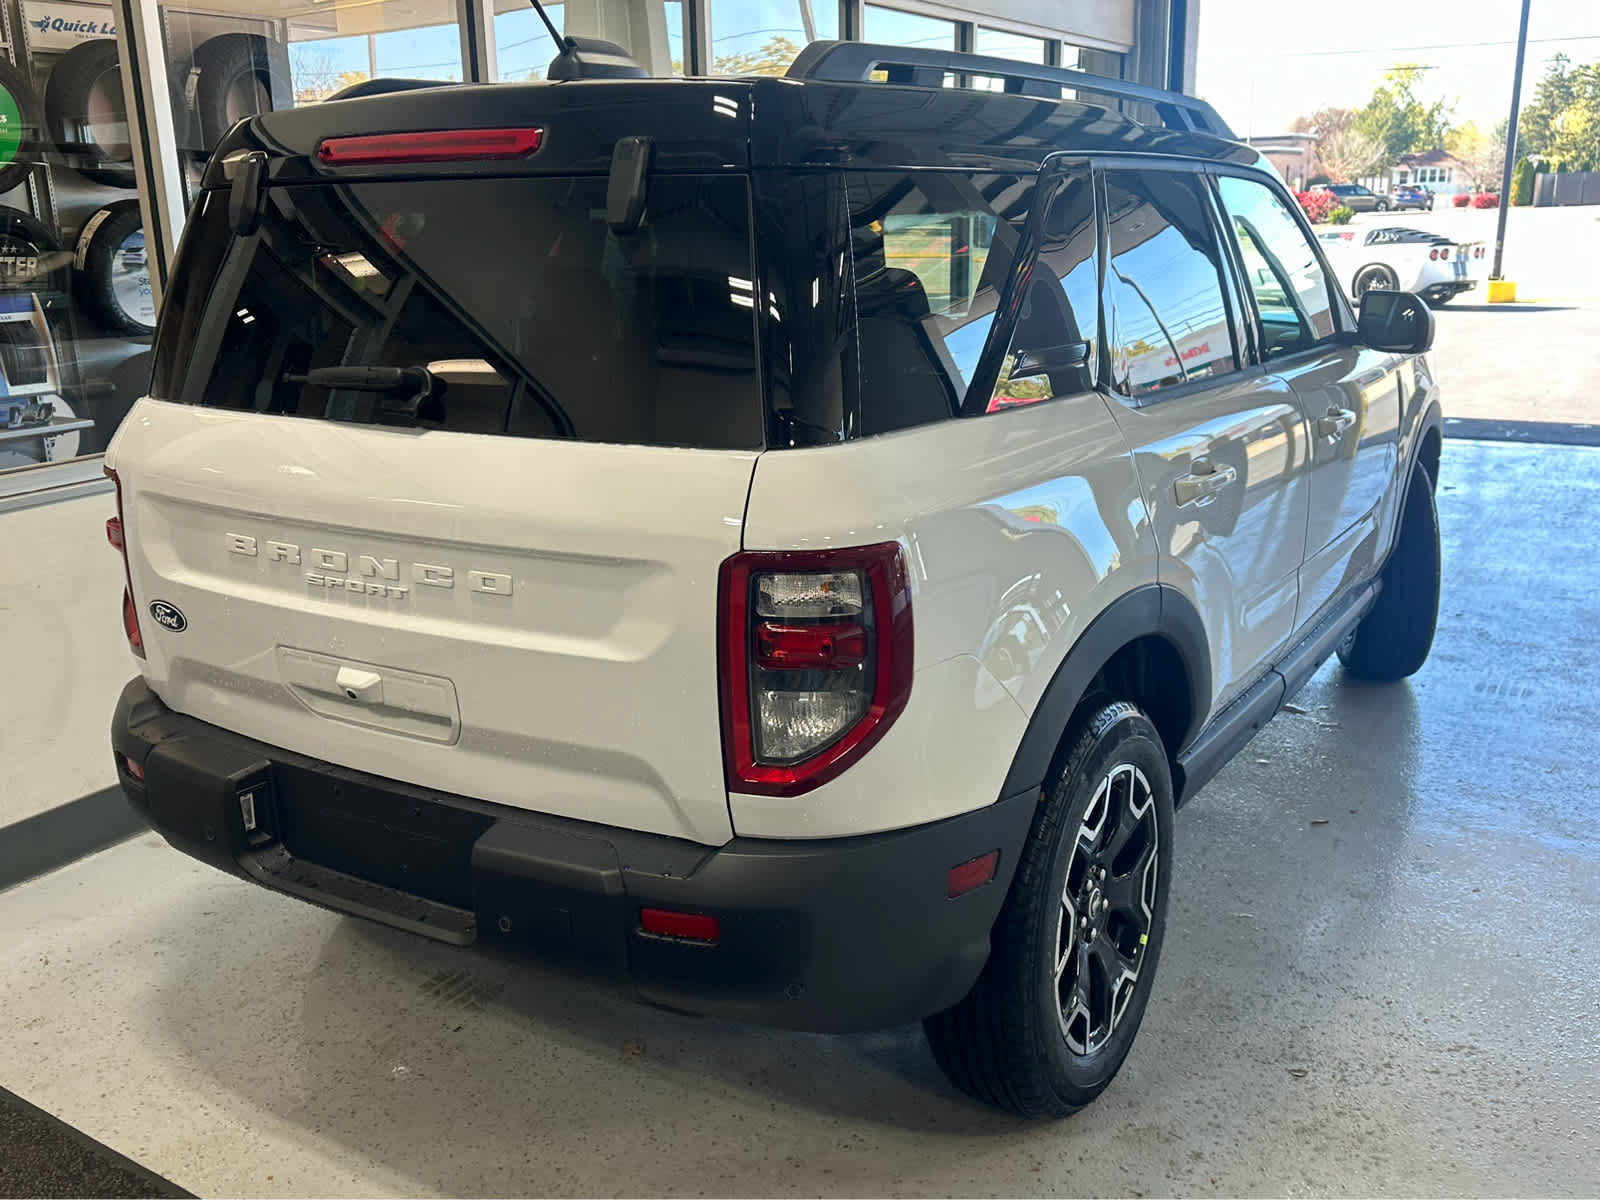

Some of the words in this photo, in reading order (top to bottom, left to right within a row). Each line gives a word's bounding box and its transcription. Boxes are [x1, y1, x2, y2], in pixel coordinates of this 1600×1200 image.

[51, 18, 98, 33] Quick
[226, 532, 514, 597] BRONCO
[304, 572, 409, 600] SPORT
[154, 603, 181, 629] Ford
